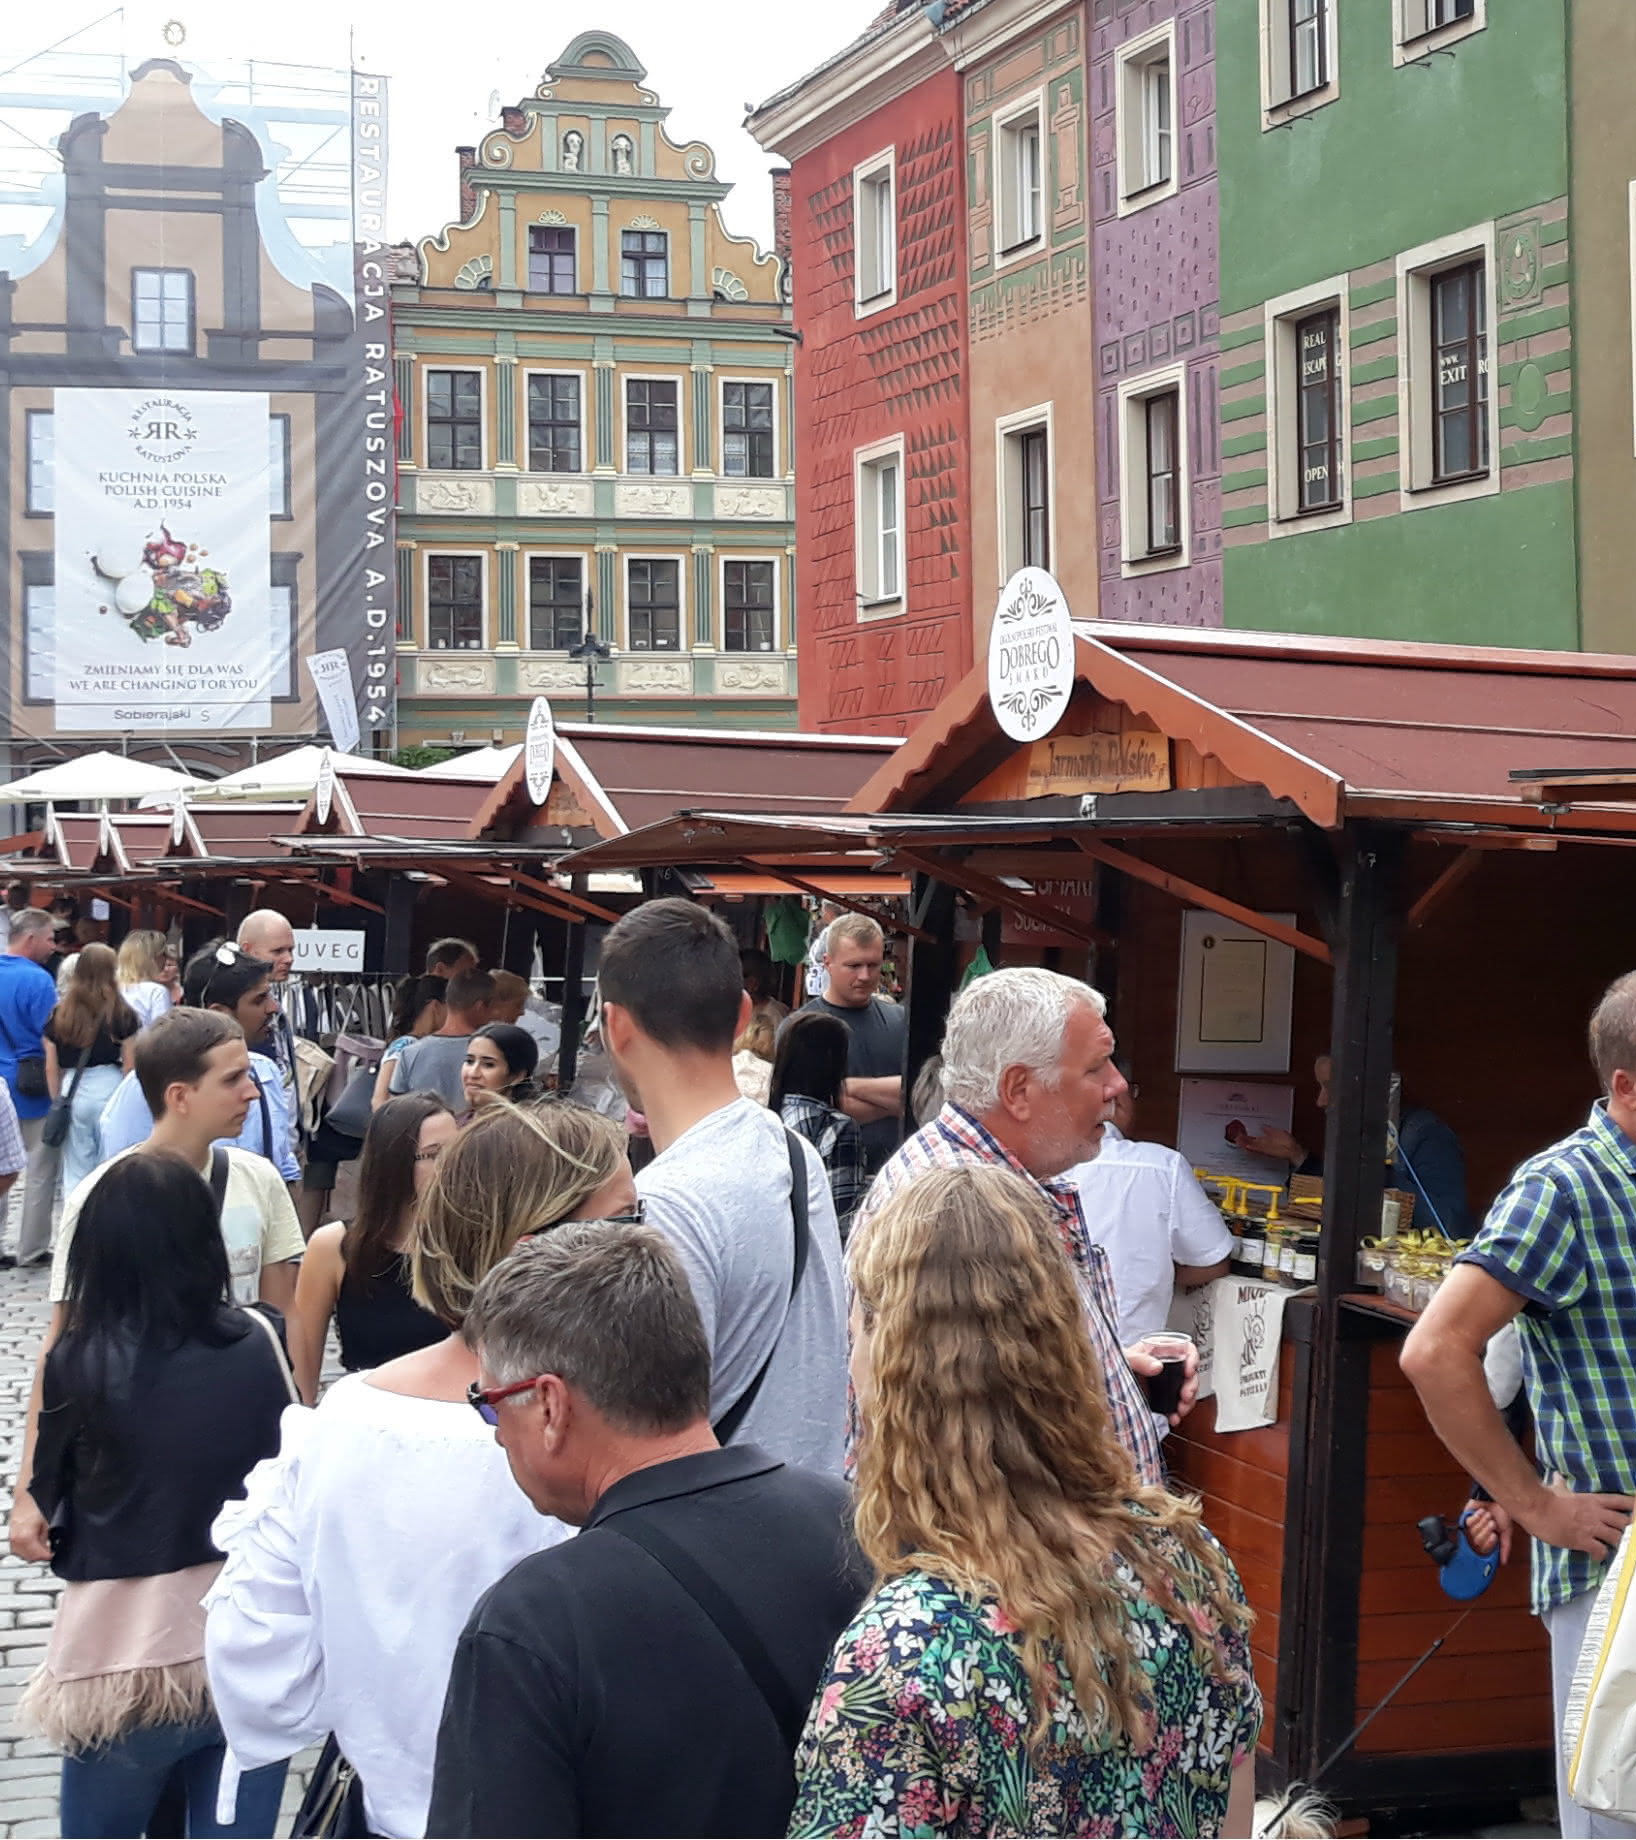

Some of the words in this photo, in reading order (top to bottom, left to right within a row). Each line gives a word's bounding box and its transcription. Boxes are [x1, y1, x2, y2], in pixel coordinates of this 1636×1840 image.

[359, 77, 385, 322] RESTAURACJA
[1304, 331, 1327, 349] REAL
[1441, 365, 1467, 385] EXIT
[364, 343, 387, 550] RATUSZOVA
[99, 471, 169, 484] KUCHNIA
[173, 472, 228, 485] POLSKA
[1305, 465, 1329, 483] OPEN
[104, 484, 158, 497] POLISH
[161, 484, 223, 498] CUISINE
[999, 635, 1060, 680] DOBREGO
[188, 665, 214, 675] DLA
[217, 665, 244, 675] WAS
[70, 679, 89, 691] WE
[93, 680, 117, 690] ARE
[121, 679, 198, 690] CHANGING
[227, 679, 258, 689] YOU
